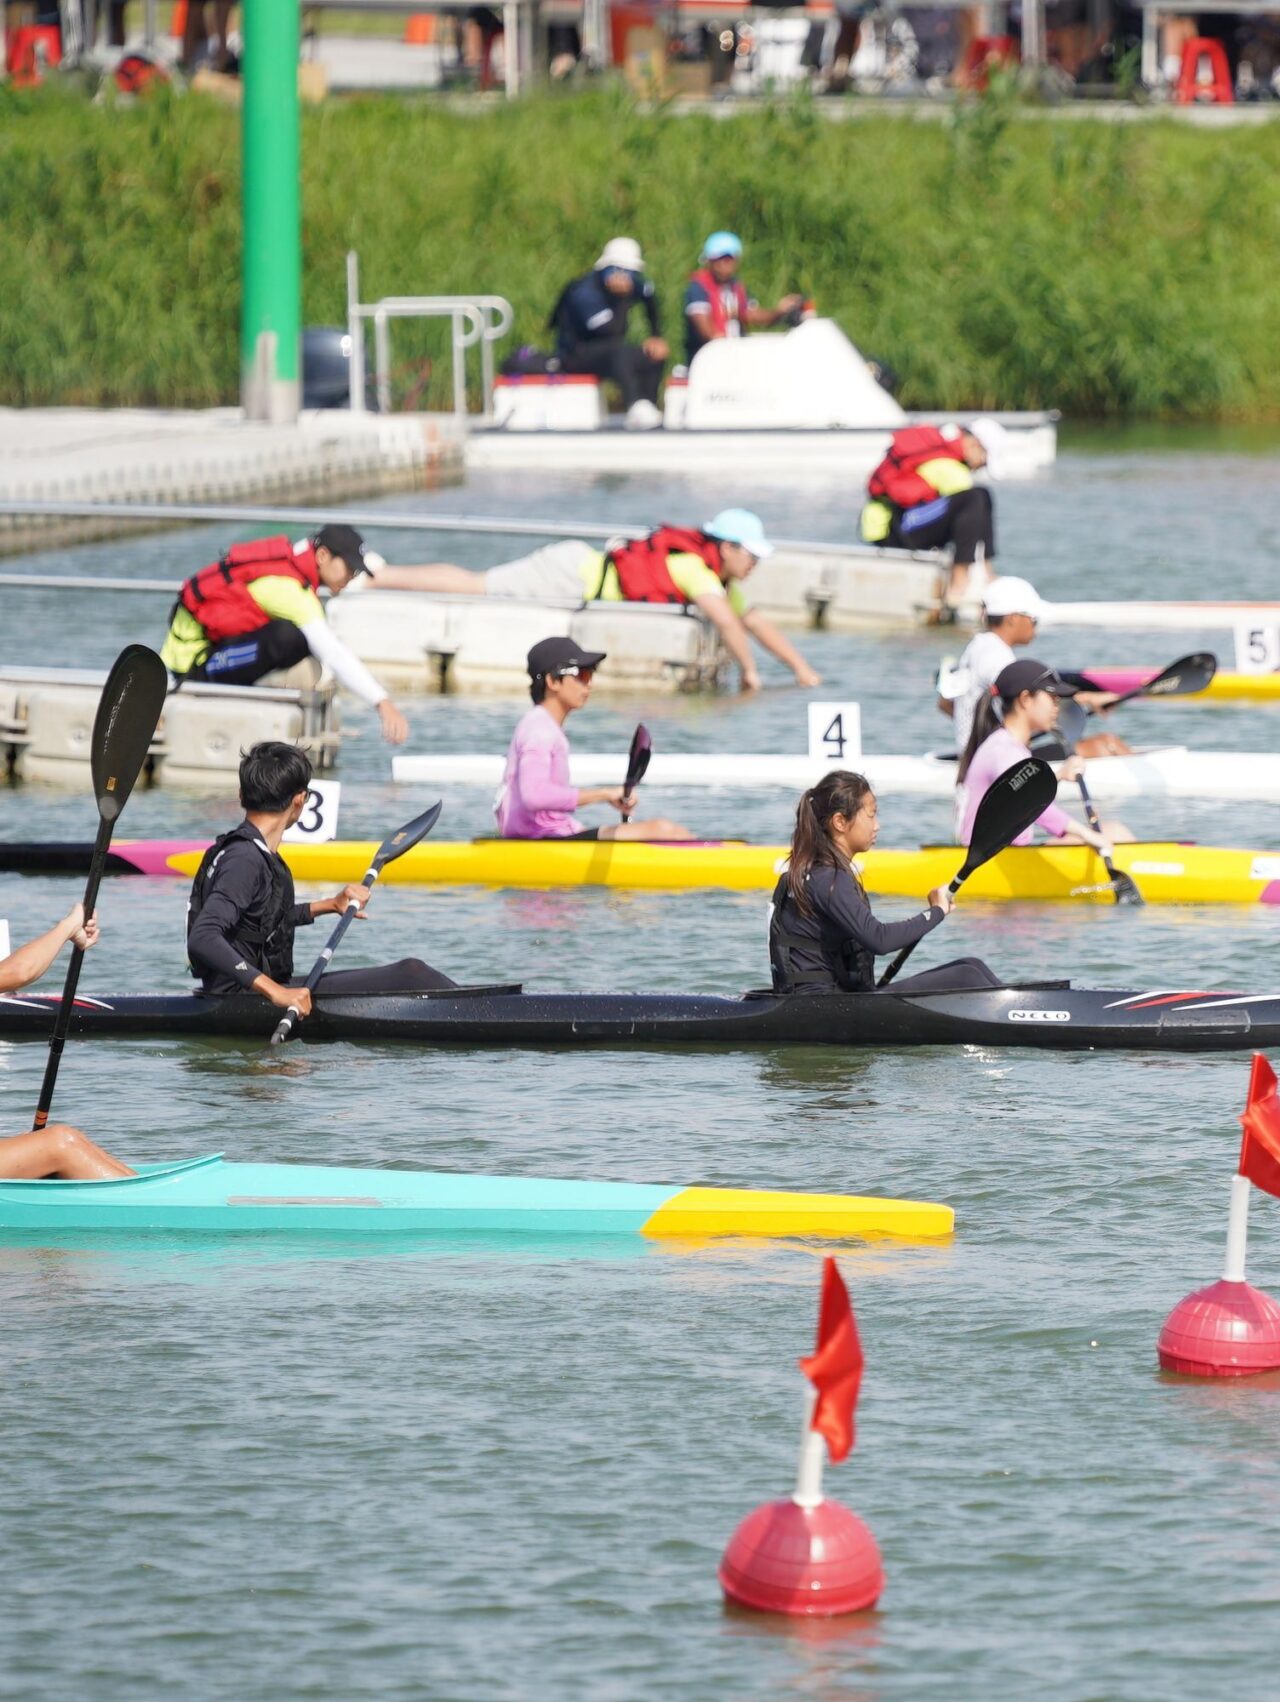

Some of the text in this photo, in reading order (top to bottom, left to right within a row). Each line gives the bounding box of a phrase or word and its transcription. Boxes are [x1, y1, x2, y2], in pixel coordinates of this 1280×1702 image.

[1248, 630, 1268, 664] 5
[822, 712, 848, 759] 4
[296, 789, 324, 833] 3
